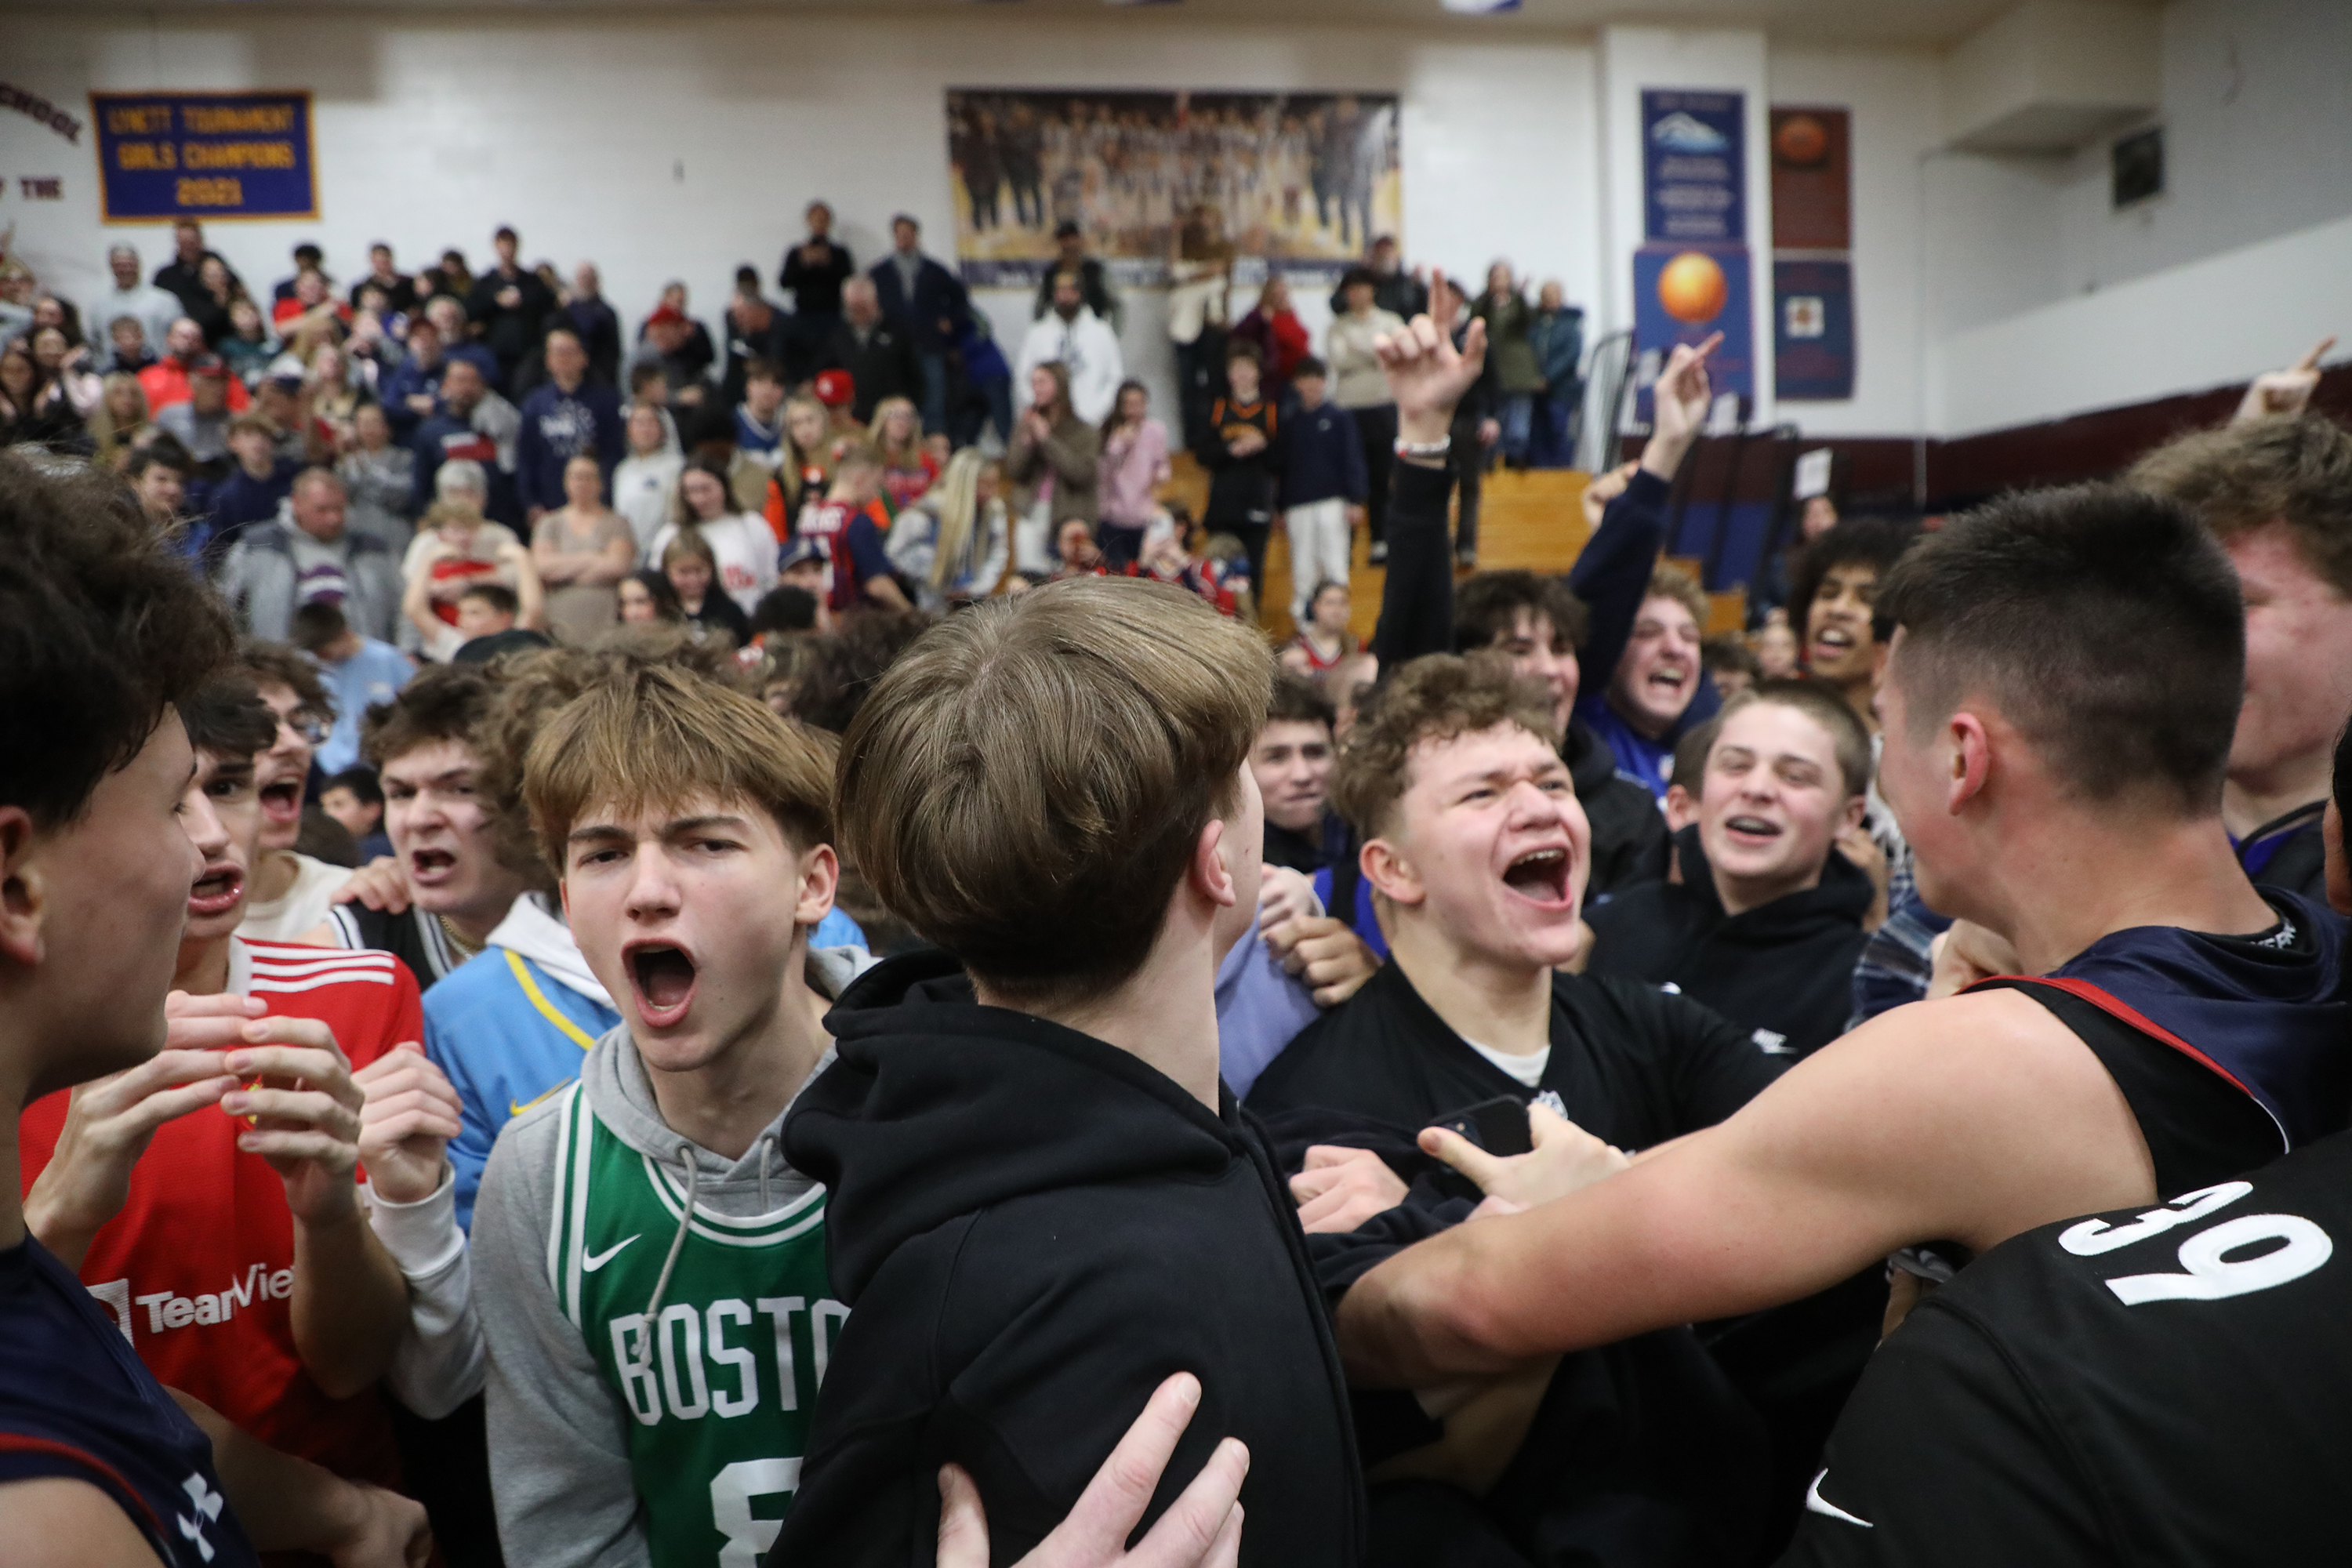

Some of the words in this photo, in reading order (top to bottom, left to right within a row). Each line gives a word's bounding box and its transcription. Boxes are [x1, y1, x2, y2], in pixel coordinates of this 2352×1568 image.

[118, 142, 177, 169] GIRLS
[182, 141, 296, 169] CHAMPIONS
[2058, 1180, 2333, 1305] 39
